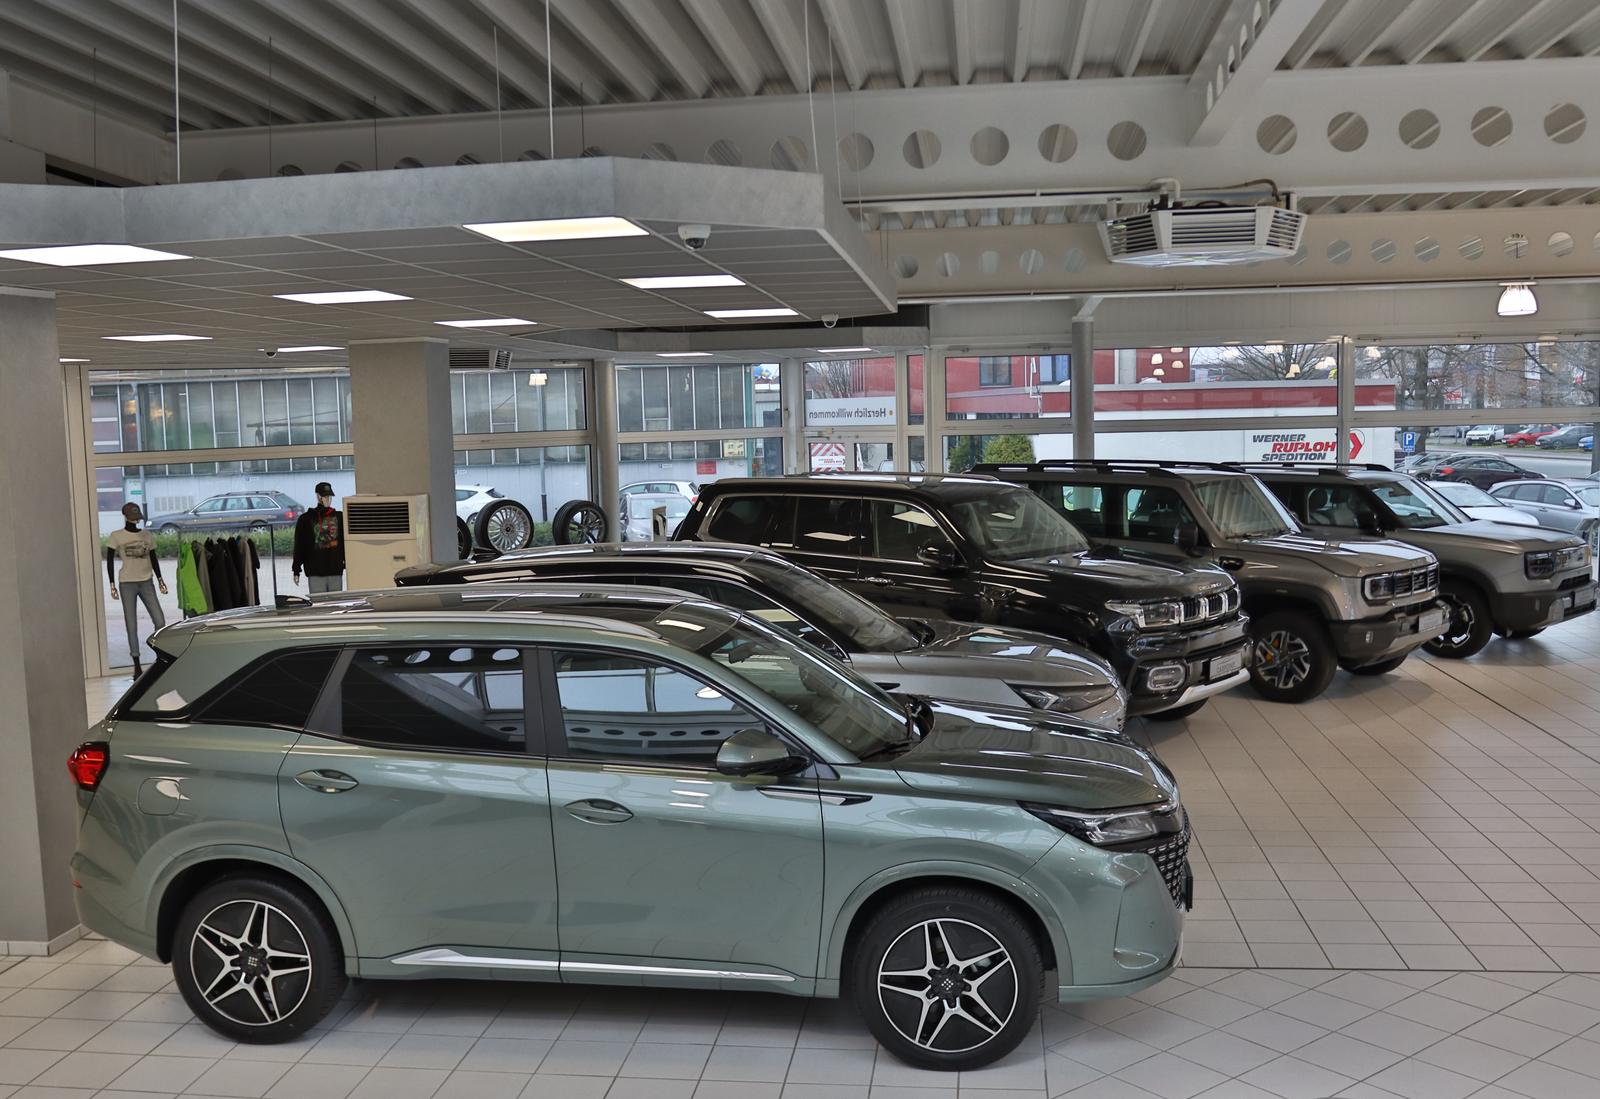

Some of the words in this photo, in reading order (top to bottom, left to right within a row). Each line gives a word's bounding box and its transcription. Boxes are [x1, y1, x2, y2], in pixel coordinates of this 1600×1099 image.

[1253, 434, 1306, 443] WERNER
[1406, 433, 1413, 445] P
[1272, 442, 1337, 453] RUPLOH
[1261, 452, 1326, 461] SPEDITION
